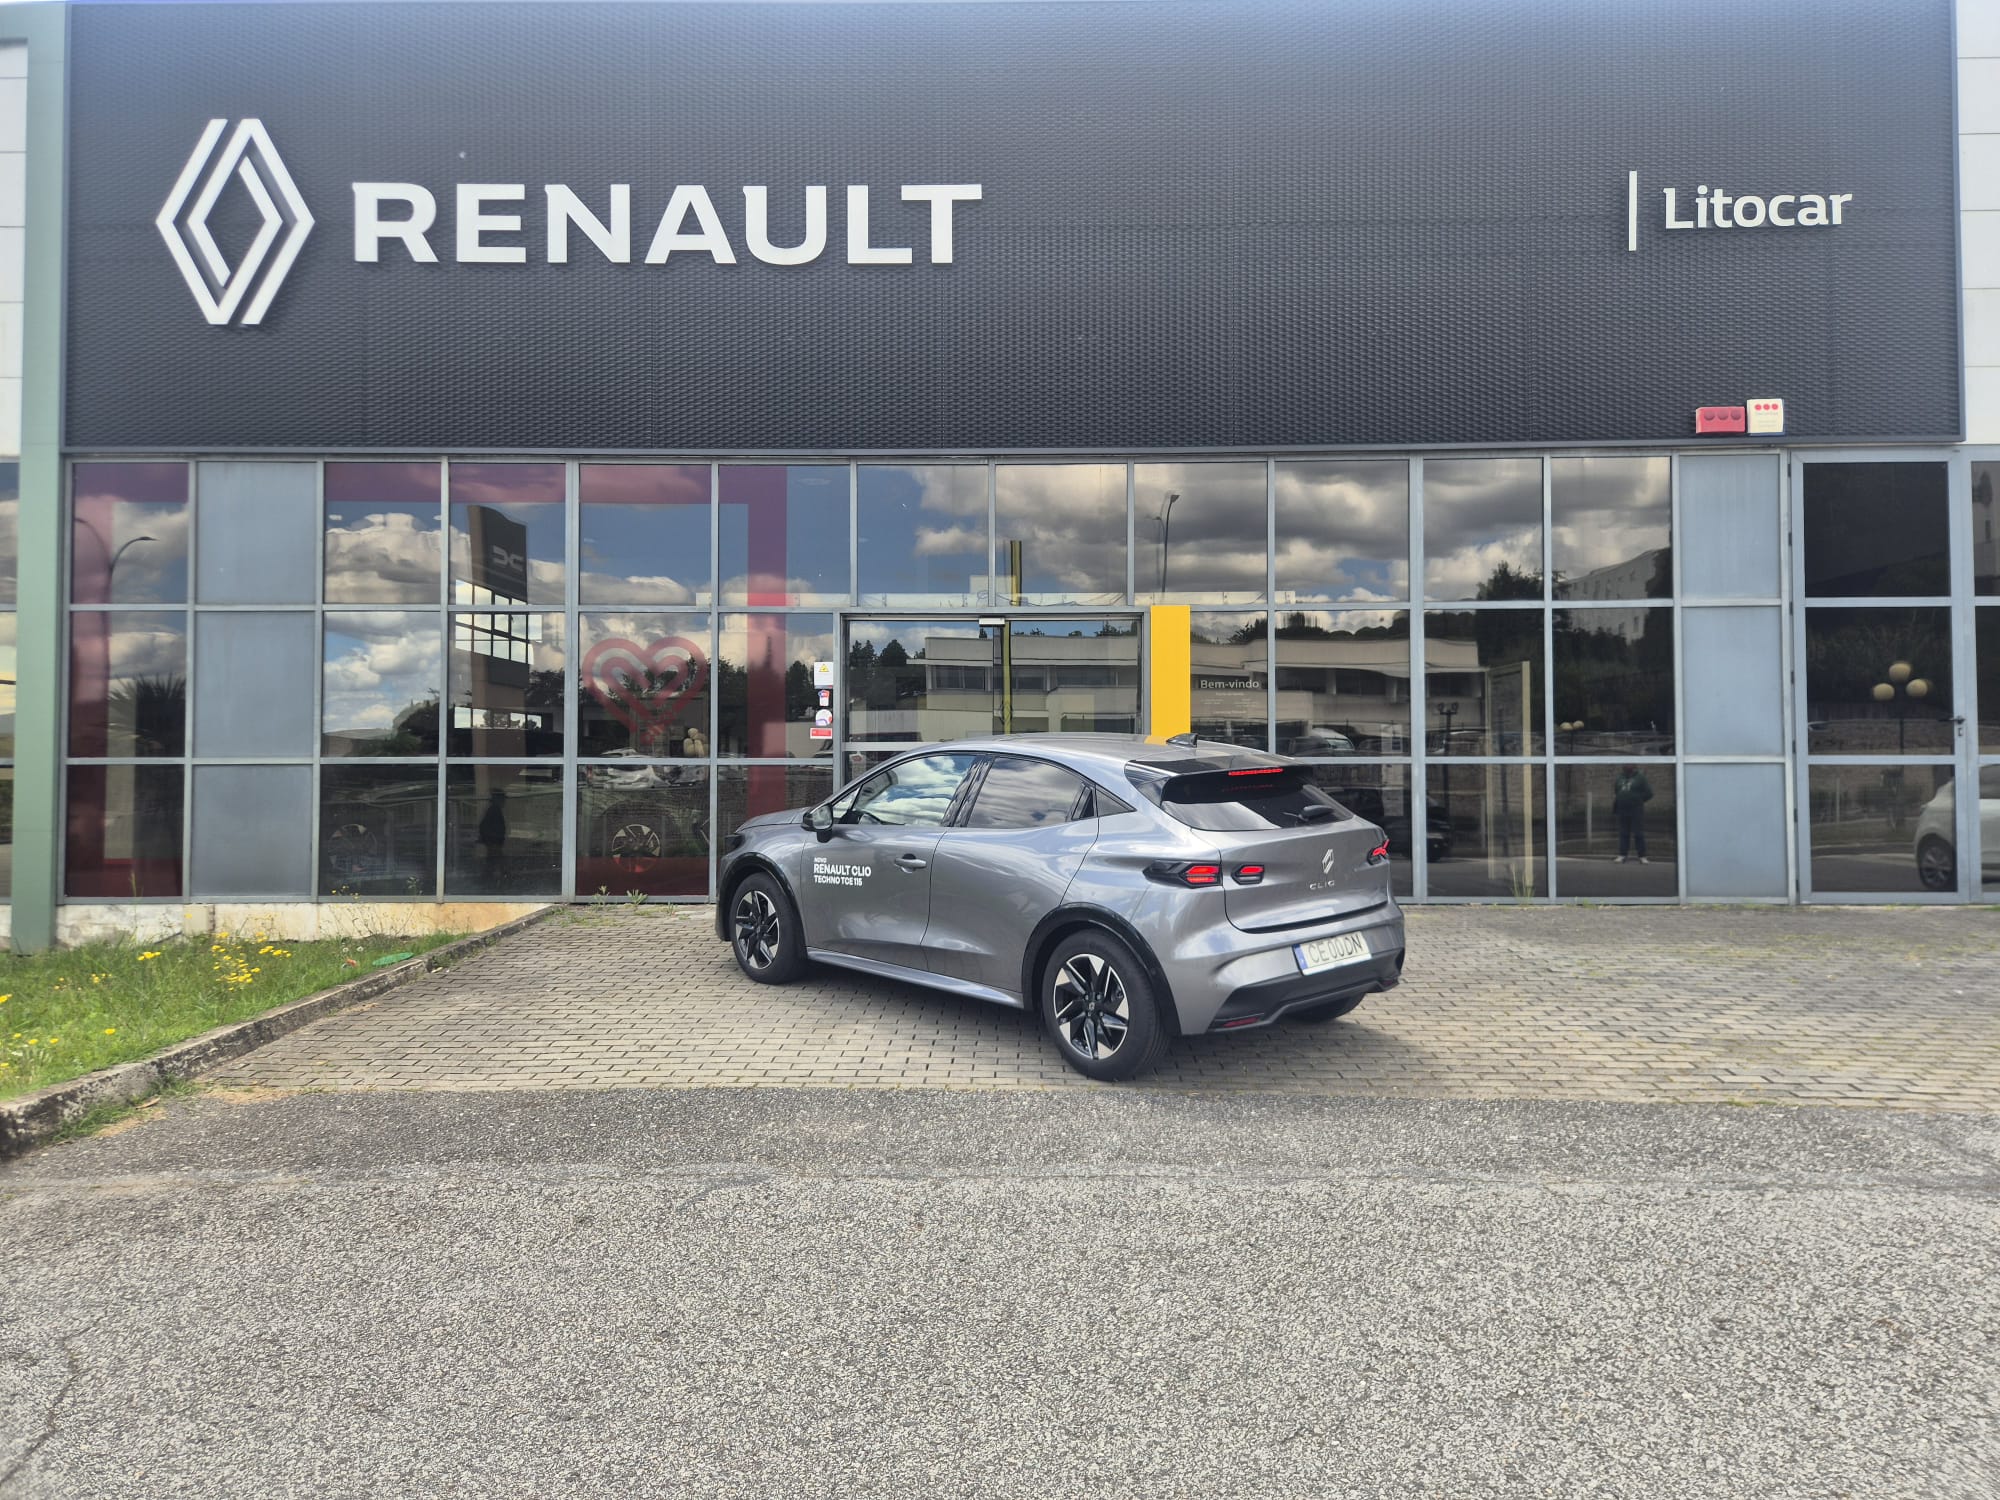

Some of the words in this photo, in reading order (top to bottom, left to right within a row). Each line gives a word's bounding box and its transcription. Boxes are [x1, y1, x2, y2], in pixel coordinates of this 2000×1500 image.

[1662, 184, 1853, 229] Litocar
[352, 182, 983, 265] RENAULT
[1200, 679, 1260, 689] Bem-vindo
[813, 863, 851, 876] RENAULT
[851, 865, 872, 877] CLIO
[813, 875, 841, 885] TECHNO
[853, 877, 863, 886] 115
